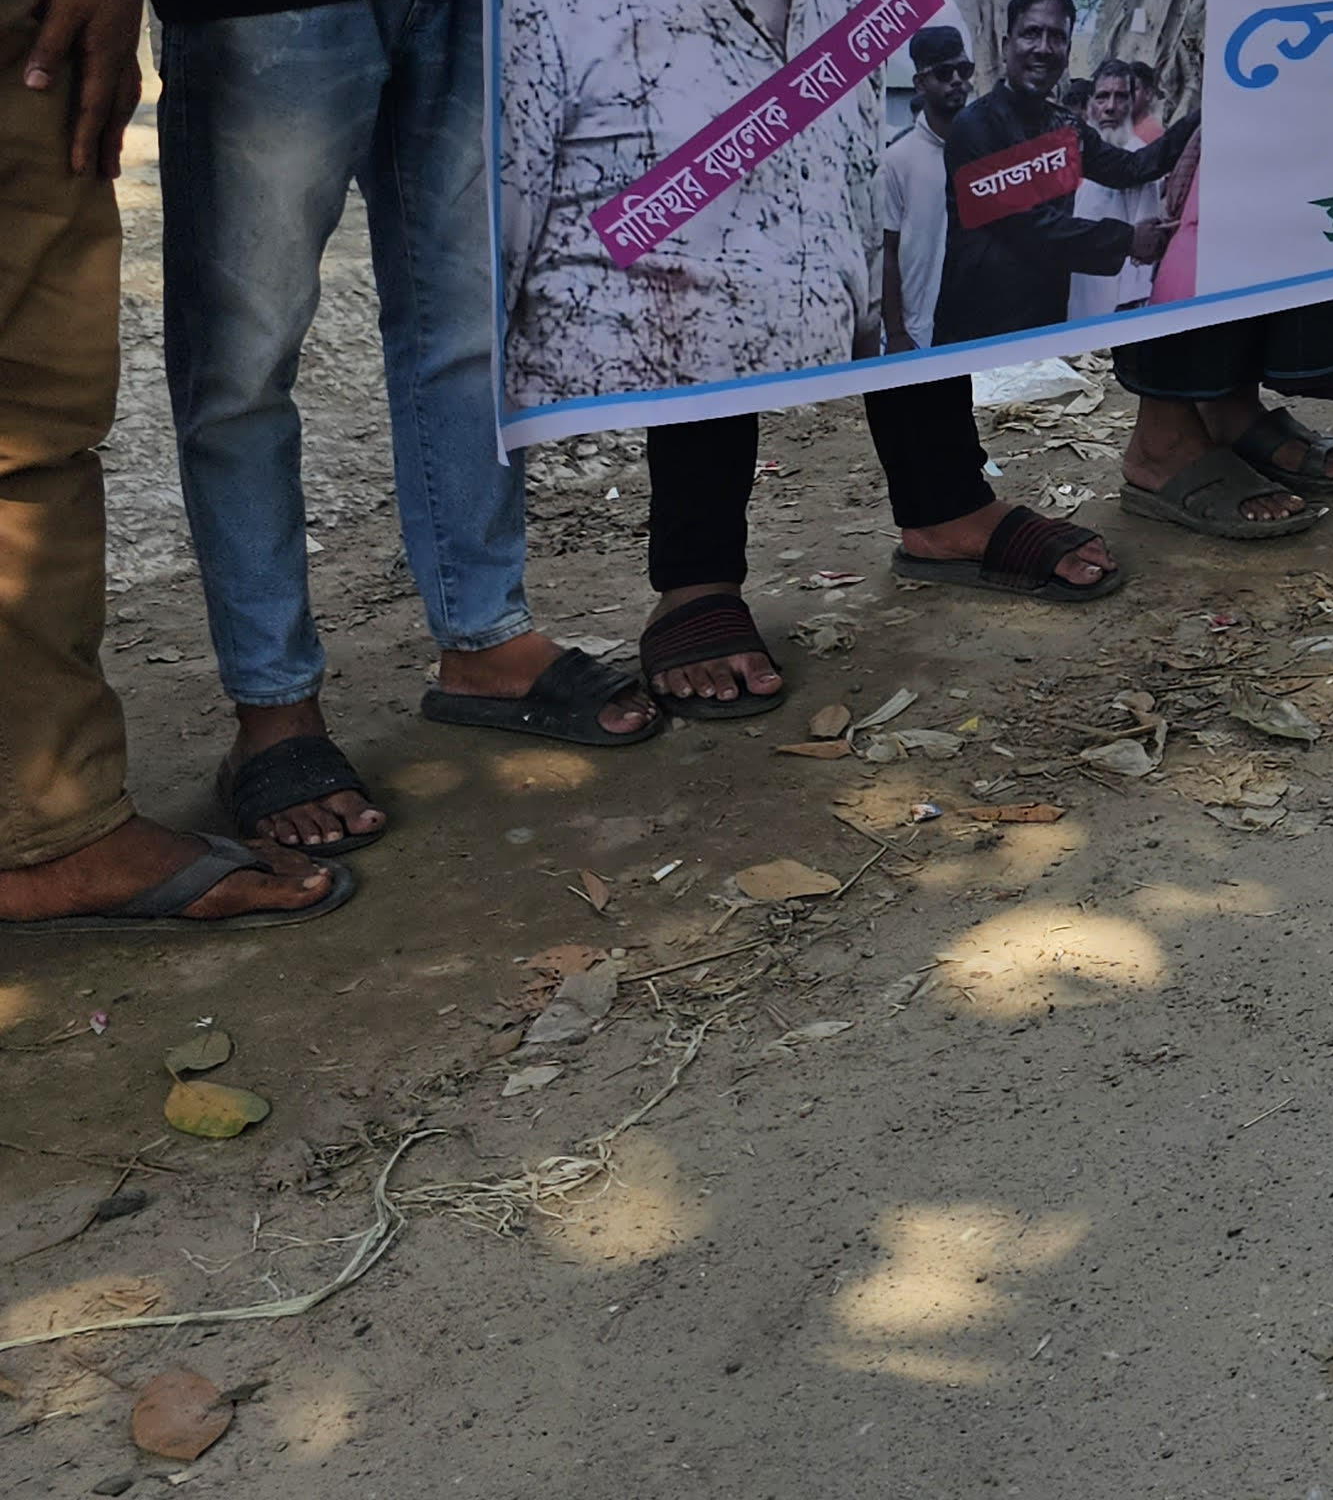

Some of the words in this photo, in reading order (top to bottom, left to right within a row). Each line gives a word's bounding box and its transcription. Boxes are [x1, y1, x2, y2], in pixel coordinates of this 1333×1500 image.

[604, 166, 709, 251] নাফিছার
[693, 96, 790, 180] বড়লোক
[788, 51, 848, 105] বাবা
[968, 146, 1067, 197] আজগর
